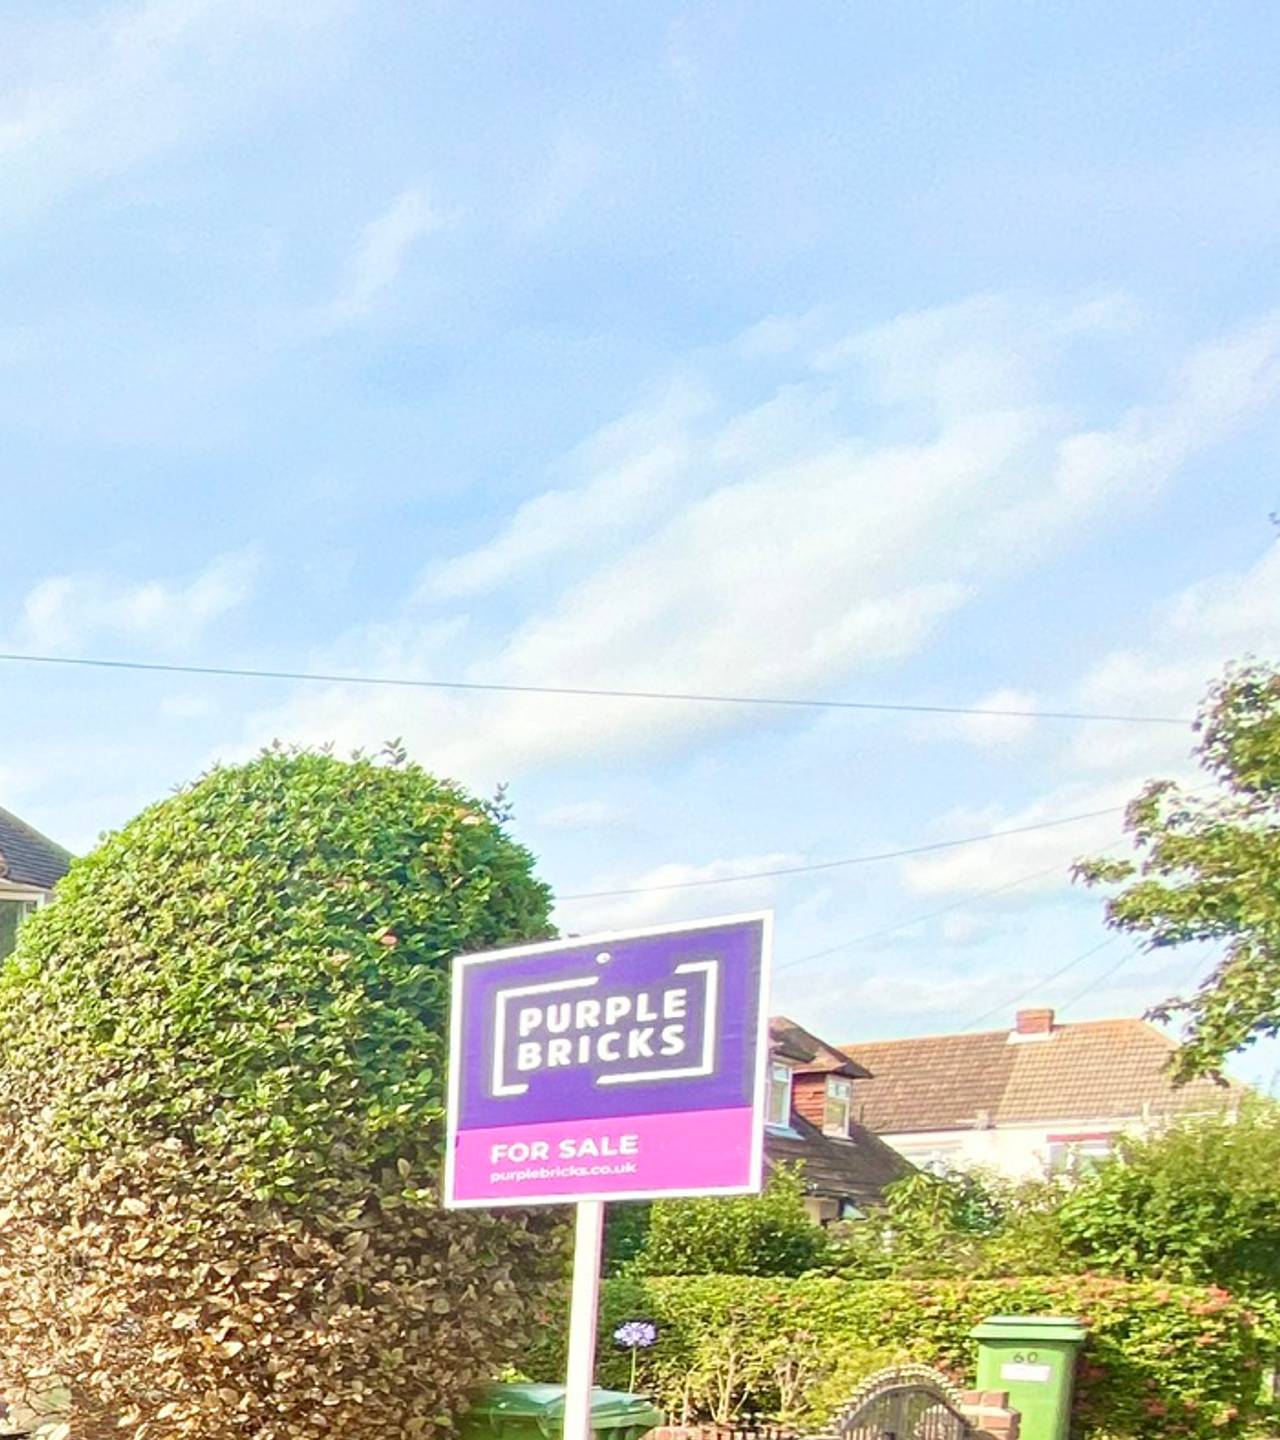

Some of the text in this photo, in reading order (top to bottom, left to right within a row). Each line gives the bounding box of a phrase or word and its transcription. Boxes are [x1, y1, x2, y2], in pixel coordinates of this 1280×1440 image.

[518, 988, 688, 1038] PURPLE
[516, 1024, 686, 1071] BRICKS
[491, 1134, 639, 1164] FOR SALE
[490, 1162, 637, 1184] purplebricks.co.uk
[1013, 1351, 1038, 1364] 60
